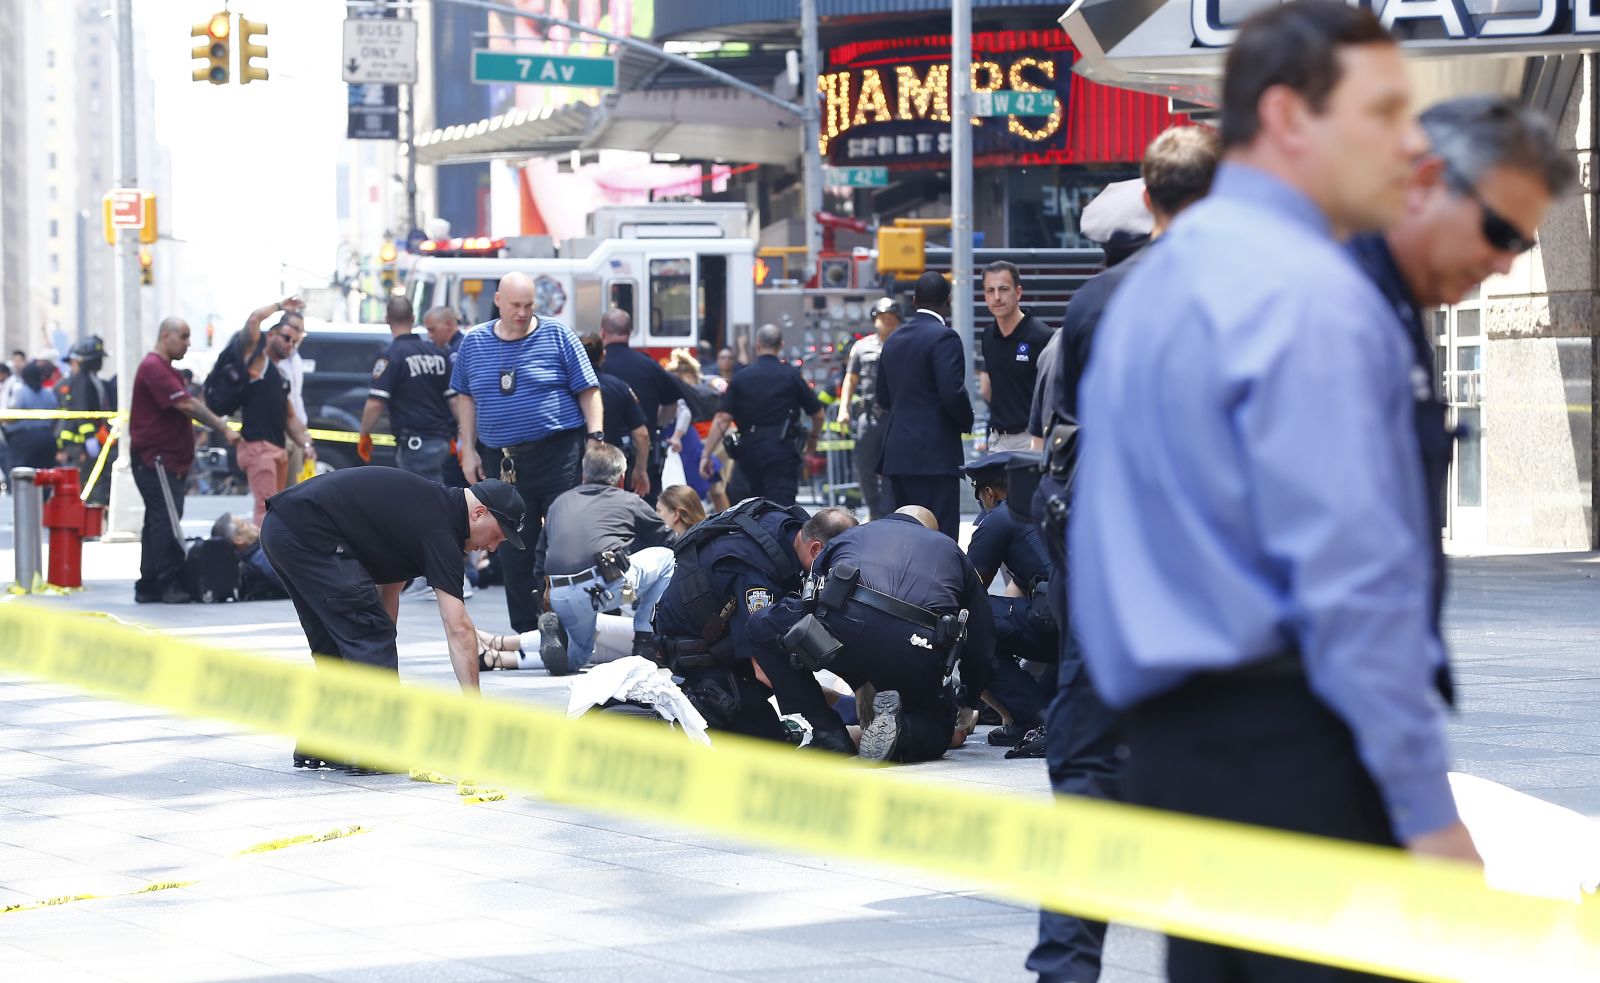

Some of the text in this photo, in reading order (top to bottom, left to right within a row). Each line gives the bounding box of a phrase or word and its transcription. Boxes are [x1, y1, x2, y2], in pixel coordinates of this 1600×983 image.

[356, 24, 403, 37] BUSES
[361, 47, 398, 59] ONLY
[516, 59, 575, 81] 7 Av
[818, 57, 1061, 156] HAMPS
[994, 94, 1009, 112] W
[1015, 94, 1035, 112] 42
[405, 355, 447, 378] NYPD
